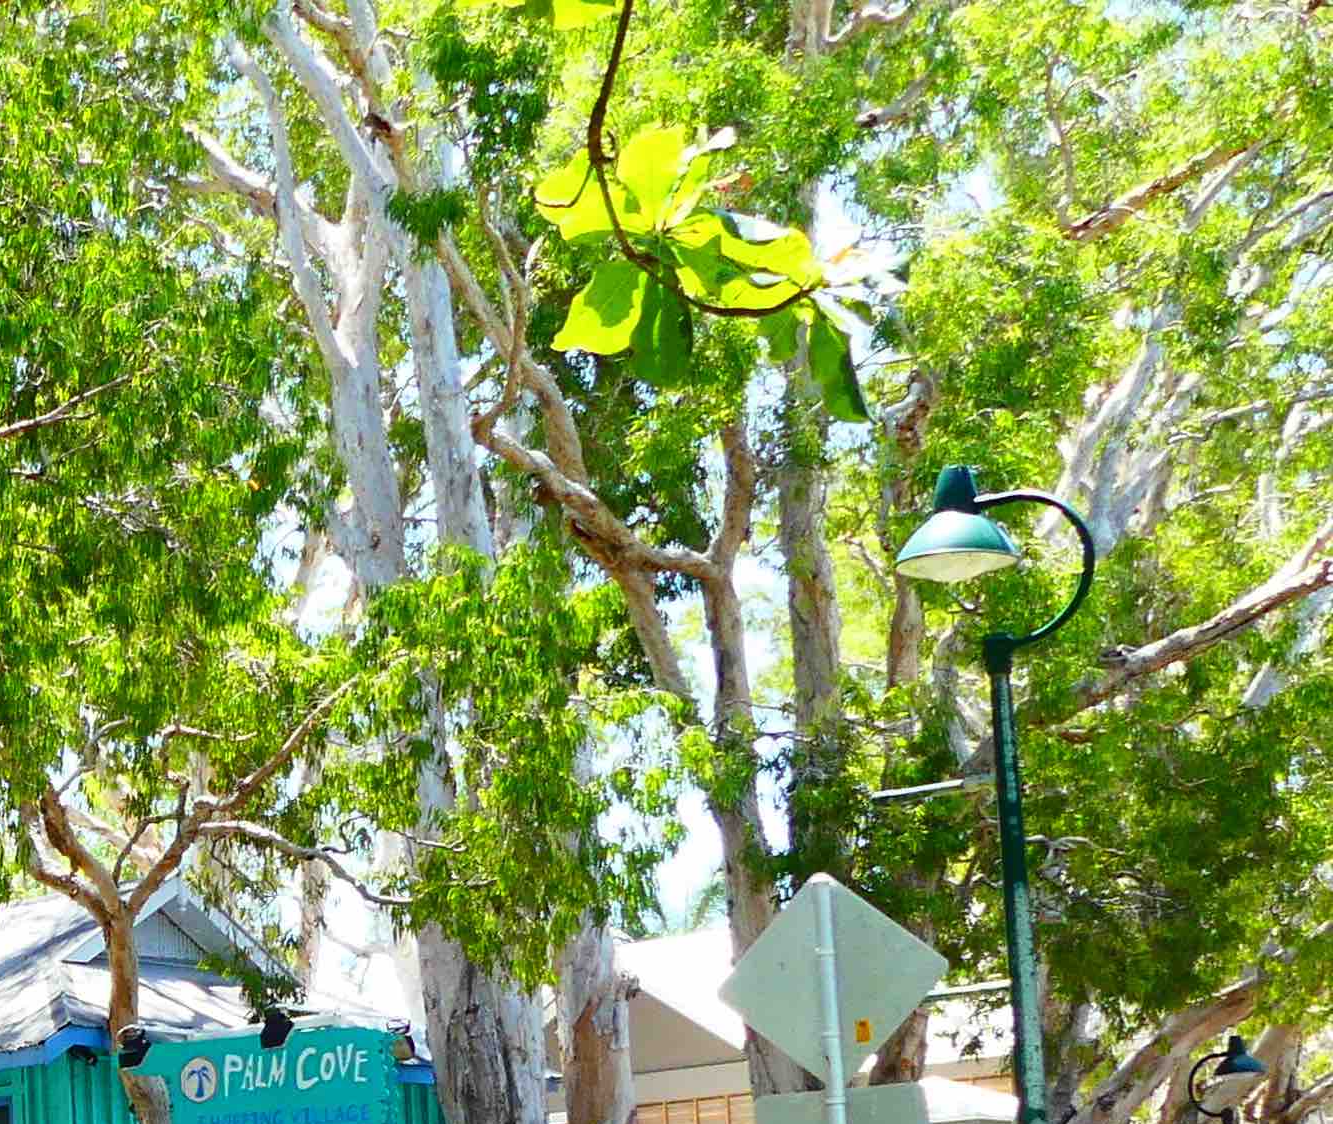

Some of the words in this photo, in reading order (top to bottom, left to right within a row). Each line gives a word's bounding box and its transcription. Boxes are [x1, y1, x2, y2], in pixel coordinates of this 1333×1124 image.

[223, 1050, 287, 1097] PALM
[295, 1043, 369, 1090] COVE
[292, 1103, 371, 1124] VILLAGE
